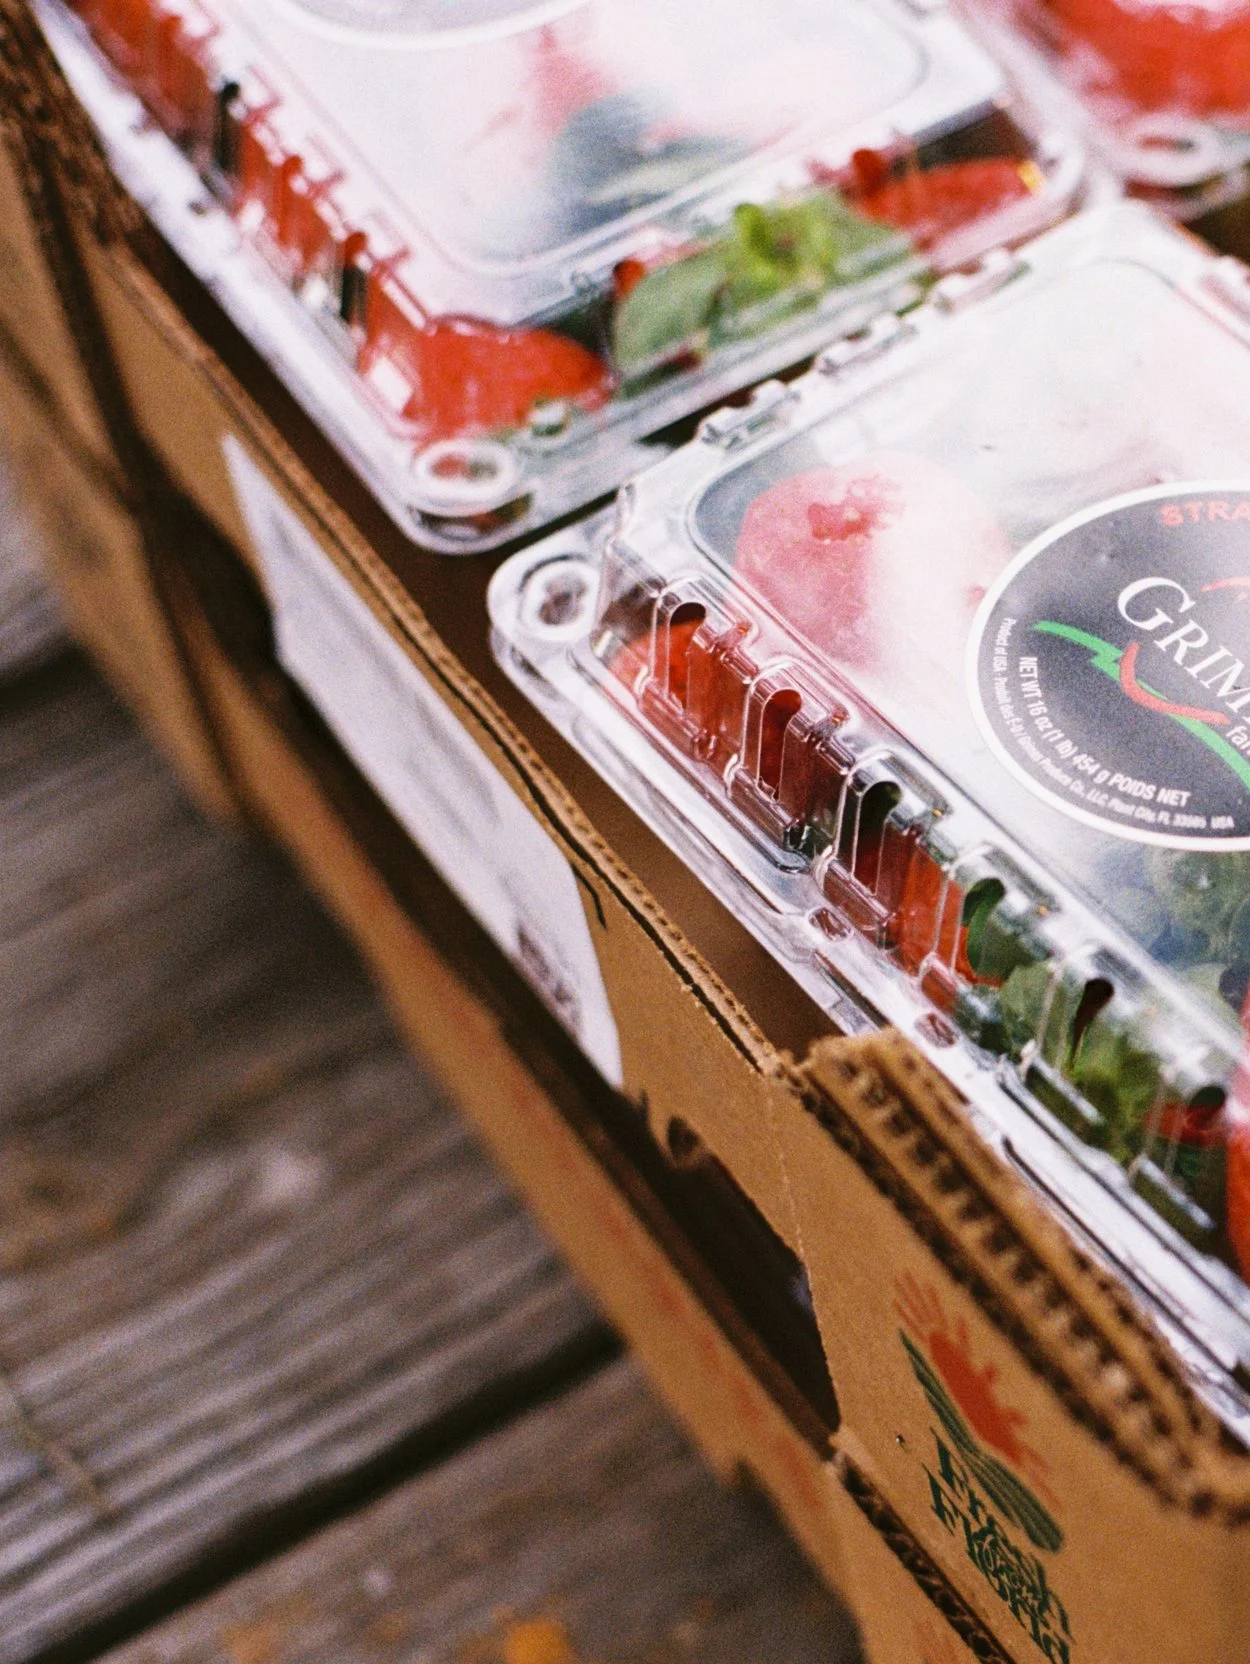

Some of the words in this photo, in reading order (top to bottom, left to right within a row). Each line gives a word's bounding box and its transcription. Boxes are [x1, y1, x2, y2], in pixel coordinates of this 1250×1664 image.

[1019, 656, 1038, 679] NET
[1021, 680, 1043, 698] WT
[1027, 700, 1049, 716] 16
[1034, 716, 1054, 732] oz
[1072, 753, 1101, 776] 454
[1093, 769, 1111, 784] g
[1107, 772, 1157, 801] POIDS
[1155, 787, 1191, 808] NET
[920, 1462, 1071, 1664] Florid
